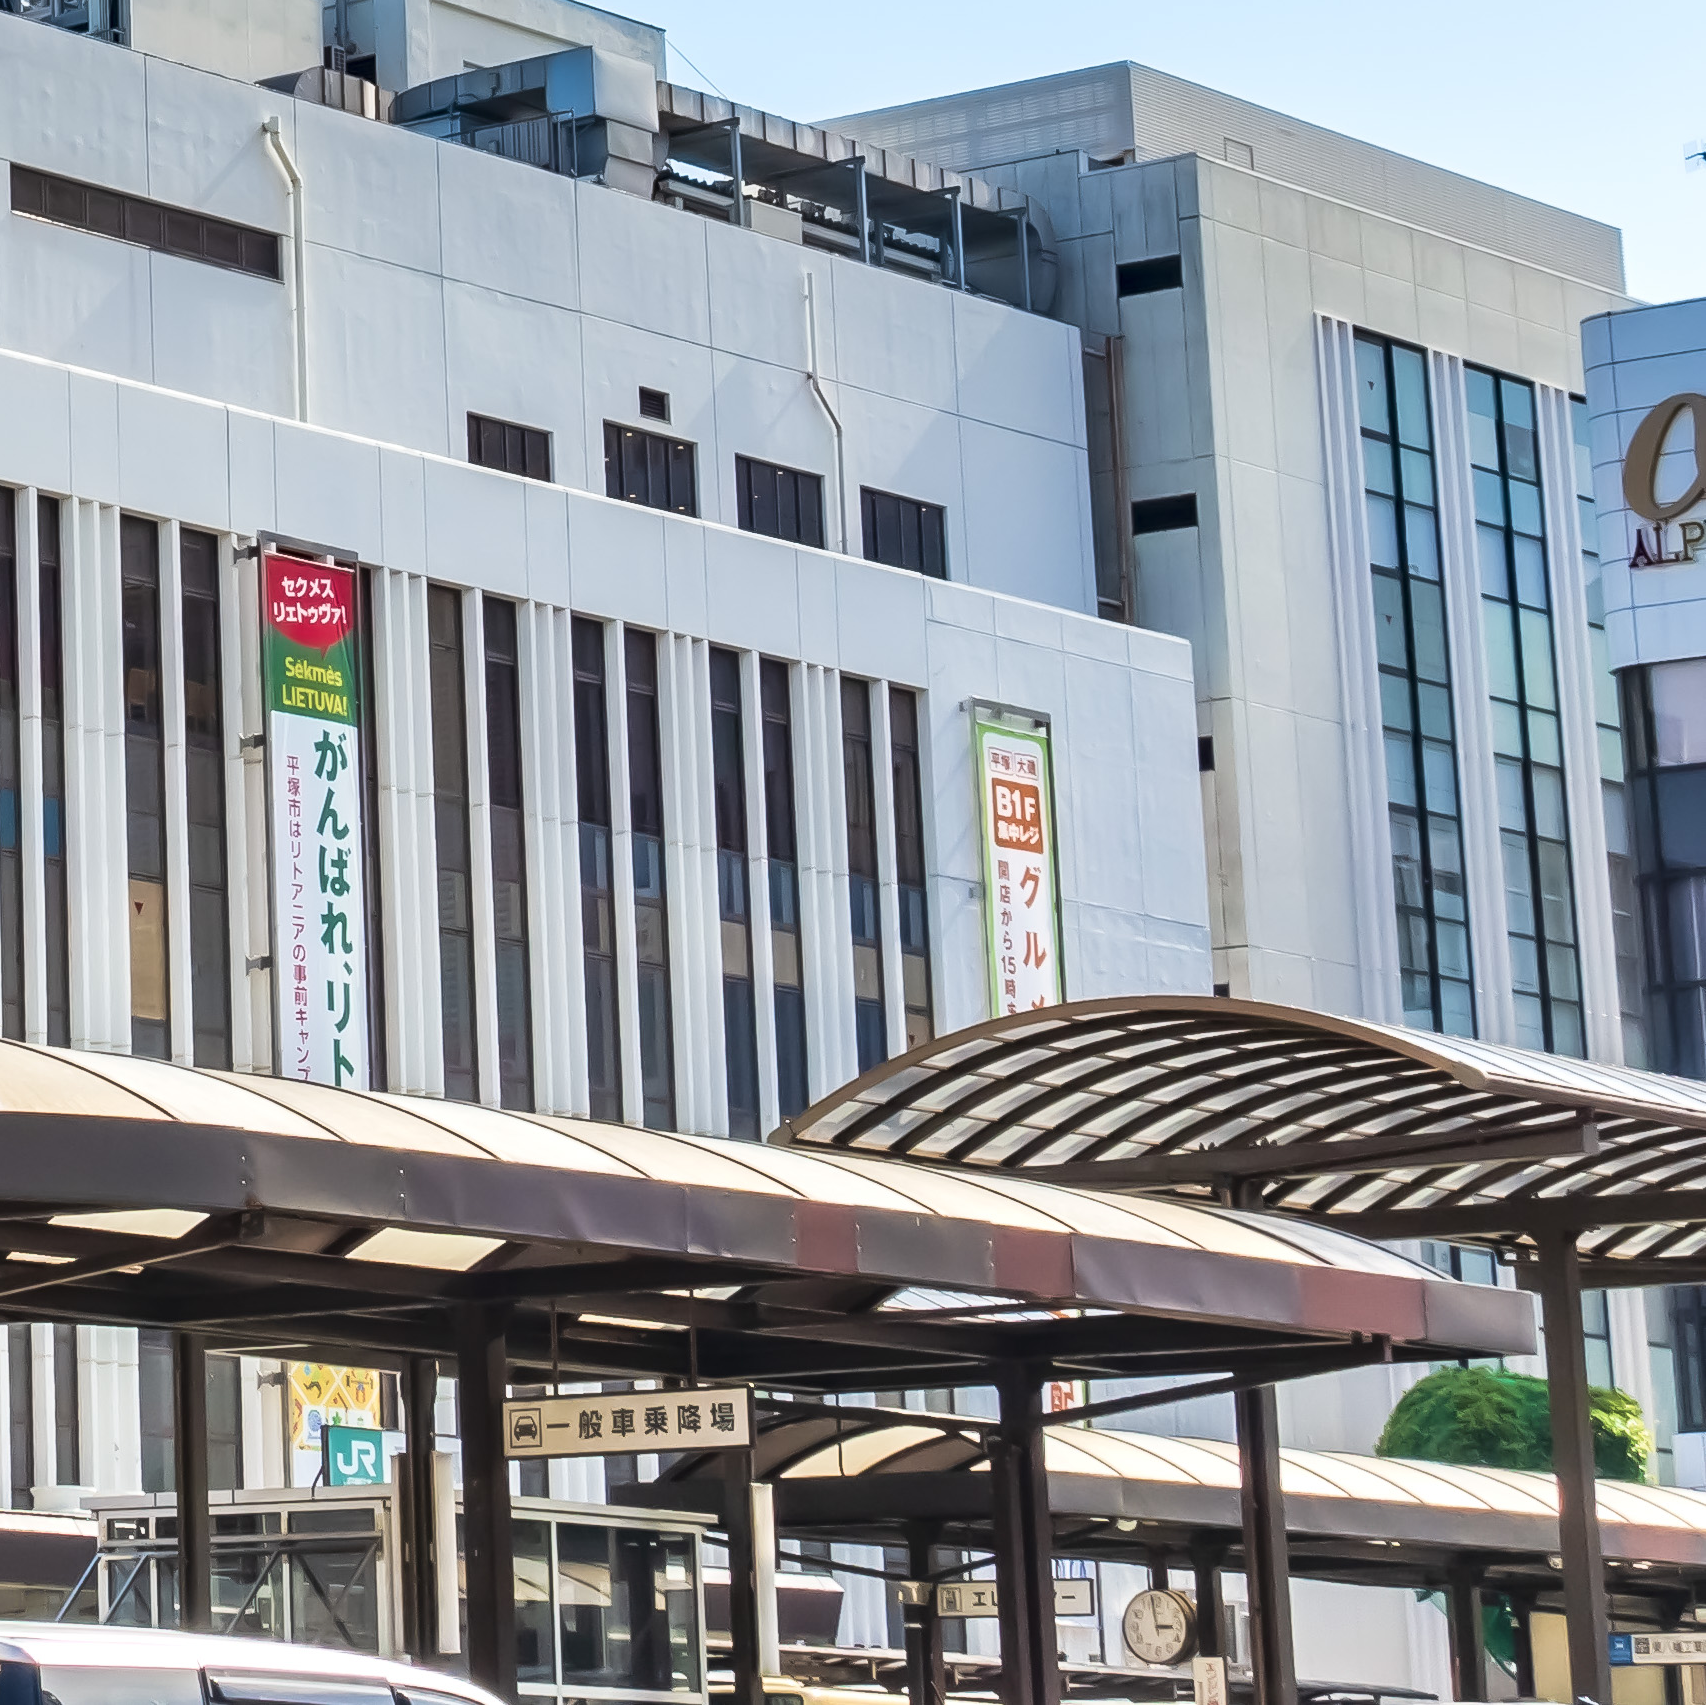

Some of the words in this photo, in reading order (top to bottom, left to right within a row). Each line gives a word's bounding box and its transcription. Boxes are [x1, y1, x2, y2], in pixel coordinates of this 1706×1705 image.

[1628, 520, 1706, 568] ALP
[281, 576, 334, 599] セクメス
[282, 684, 347, 716] LIETUVA!
[995, 785, 1036, 821] B1F
[545, 1402, 735, 1440] 一般車乗降場
[336, 1440, 377, 1477] JR
